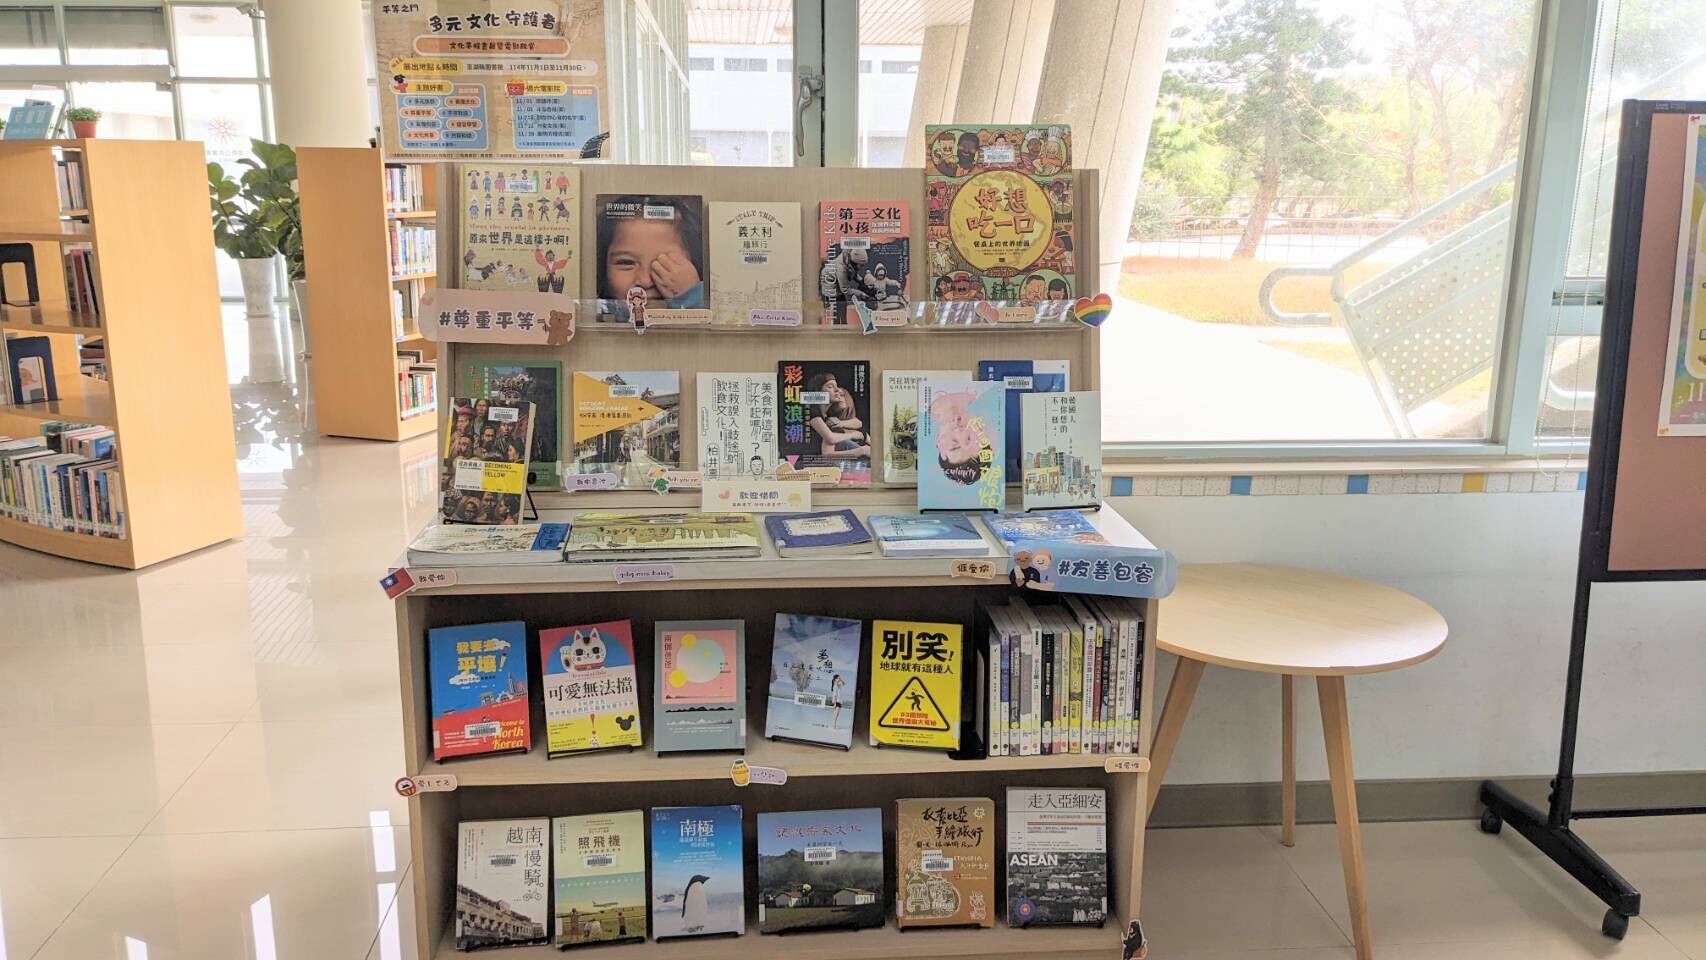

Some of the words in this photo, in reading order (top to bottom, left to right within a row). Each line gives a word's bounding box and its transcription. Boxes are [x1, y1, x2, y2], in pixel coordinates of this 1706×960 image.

[382, 4, 419, 13] 平等之門
[429, 10, 556, 32] 多元文化守護者
[974, 187, 1028, 213] 好想
[824, 206, 837, 234] Kids
[839, 207, 901, 220] 第三文化
[738, 226, 772, 238] 義大利
[839, 222, 870, 234] 小孩
[966, 212, 1037, 239] 吃一口
[439, 309, 535, 330] #尊重平等
[784, 365, 803, 444] 彩虹浪潮
[1058, 560, 1154, 584] #友善包容
[881, 630, 954, 662] 別笑!
[879, 661, 954, 675] 地球就有這種人
[549, 676, 633, 702] 可愛無法擋
[1027, 792, 1102, 809] 走入亞細安
[680, 818, 715, 838] 南極
[578, 834, 621, 850] 照飛機
[1009, 854, 1059, 867] ASEAN
